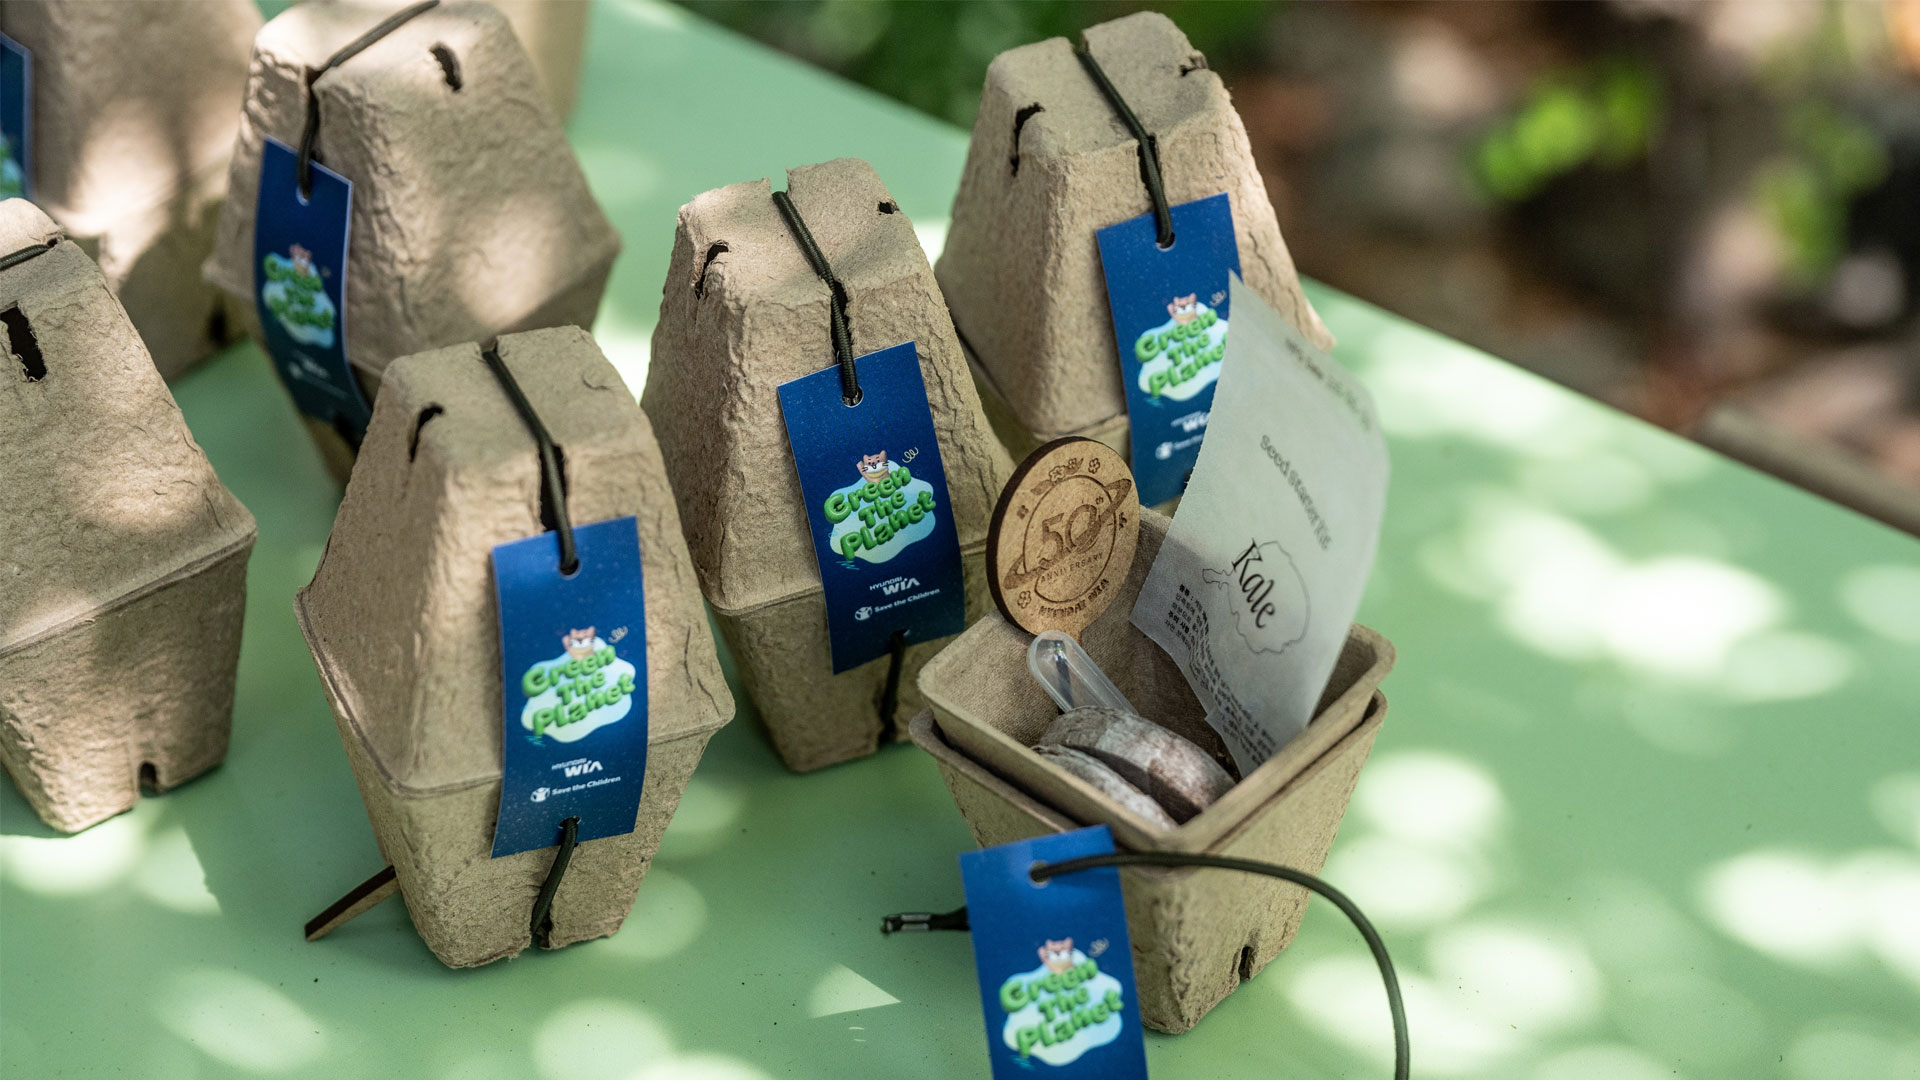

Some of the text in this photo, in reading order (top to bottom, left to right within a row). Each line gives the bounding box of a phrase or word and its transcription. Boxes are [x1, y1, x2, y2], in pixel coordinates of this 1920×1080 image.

[1135, 308, 1218, 363] Green
[1167, 332, 1210, 366] The
[823, 466, 912, 524] Green
[858, 491, 907, 529] The
[840, 490, 936, 561] Planet
[869, 576, 903, 591] HYUNDAI
[874, 602, 893, 613] Save
[907, 588, 940, 602] Children
[1231, 537, 1276, 629] Kale
[521, 644, 616, 697] Green
[556, 670, 606, 705] The
[533, 673, 636, 736] Planet
[551, 775, 621, 796] Save the Children
[999, 958, 1098, 1013] Green
[1038, 986, 1090, 1022] The
[1017, 989, 1124, 1059] Planet
